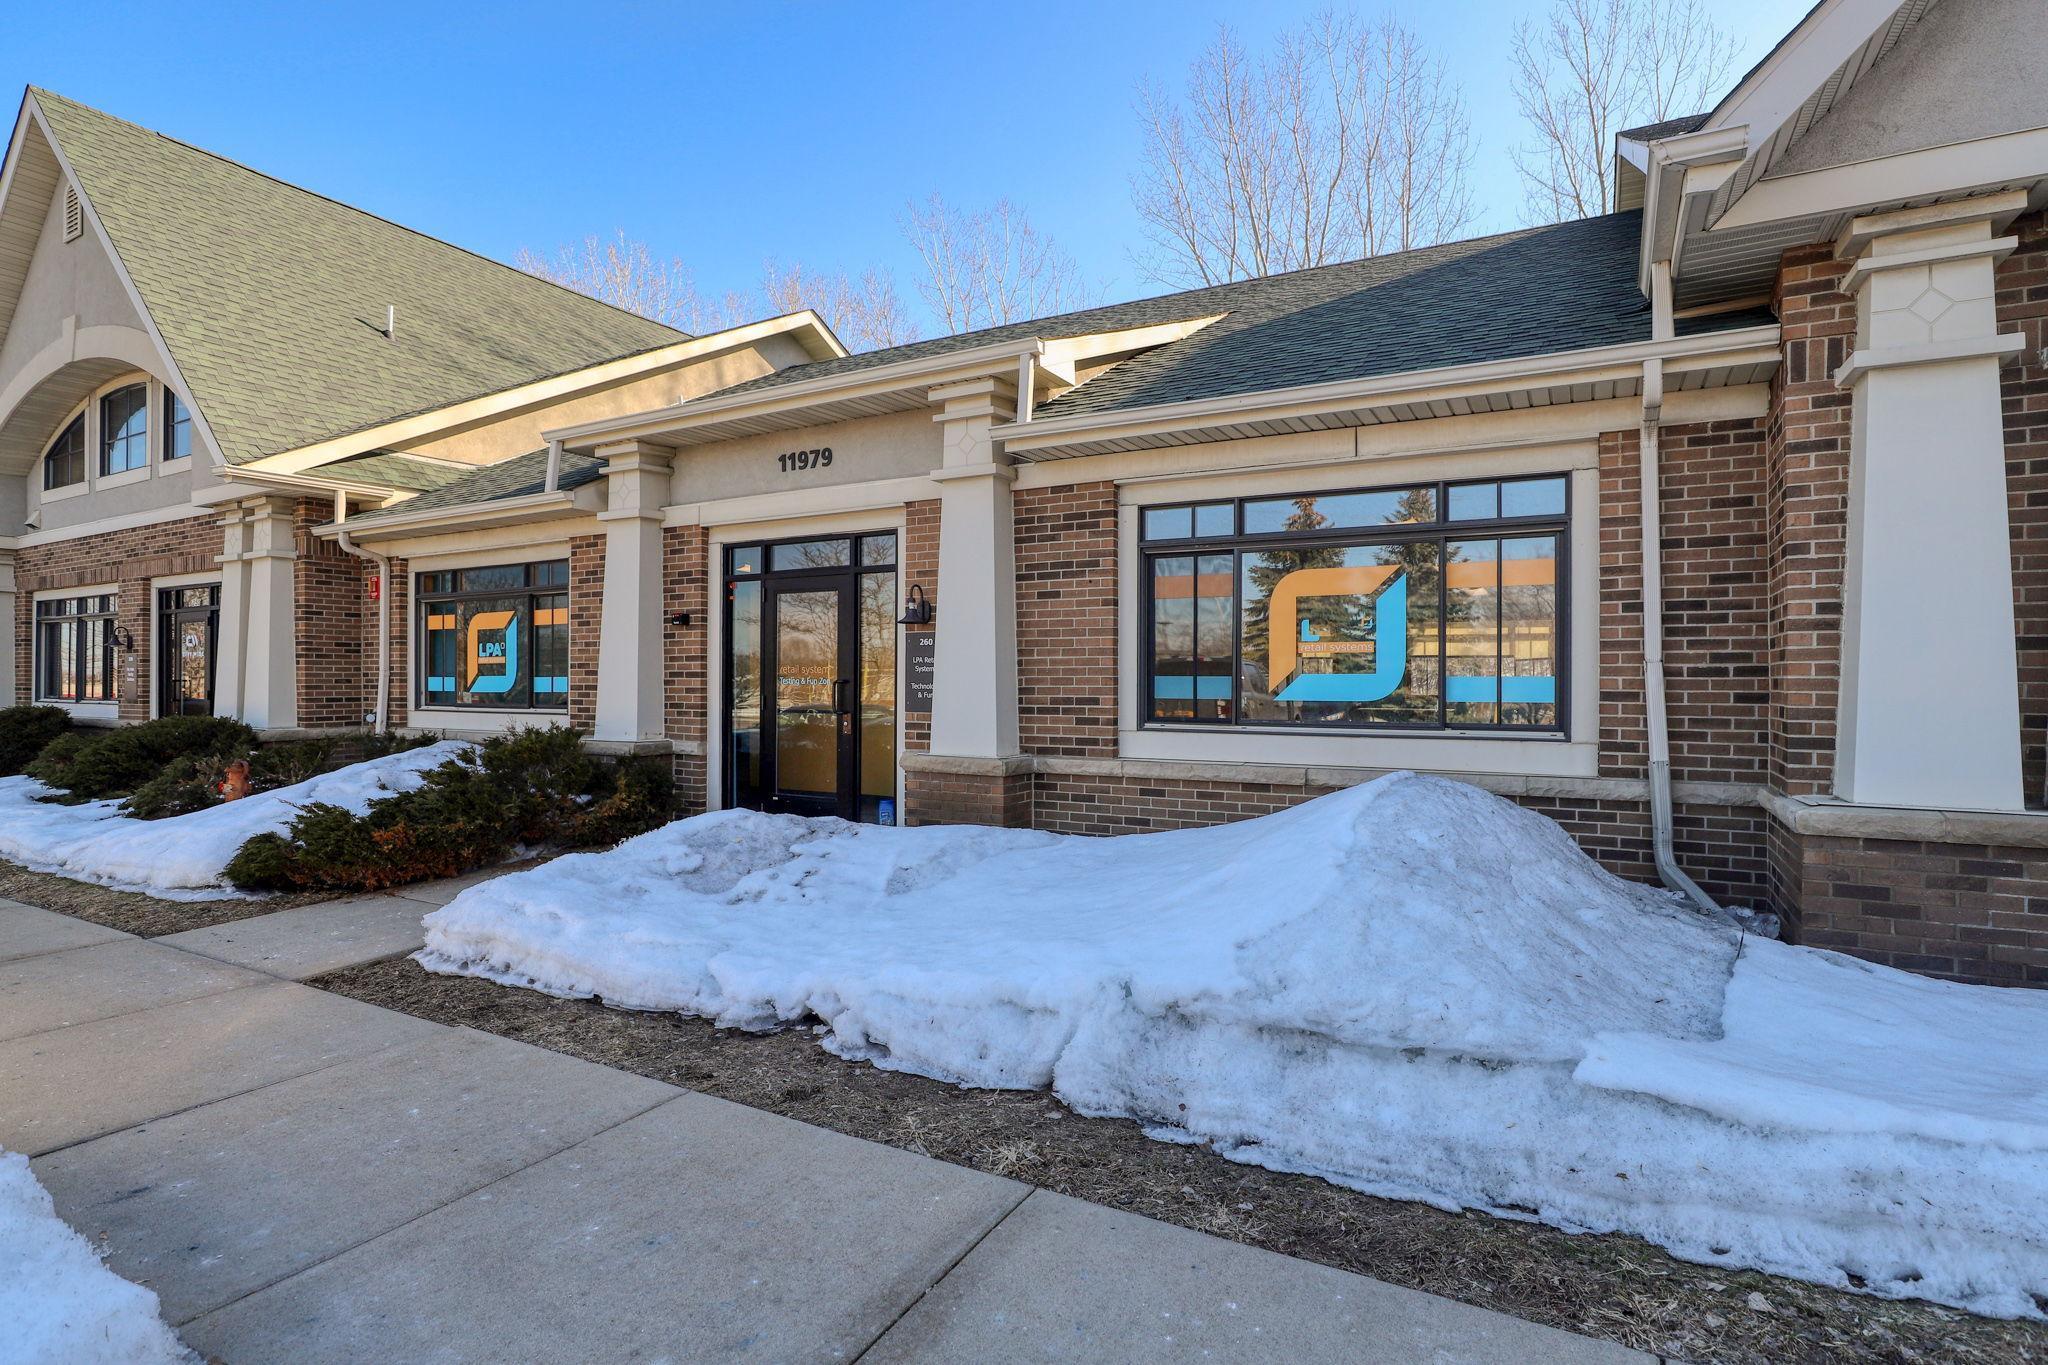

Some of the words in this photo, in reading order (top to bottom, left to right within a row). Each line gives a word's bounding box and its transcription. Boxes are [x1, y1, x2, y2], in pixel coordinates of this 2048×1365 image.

[778, 447, 833, 472] 11979
[919, 638, 933, 646] 260
[1300, 642, 1327, 652] retail
[1329, 642, 1373, 653] systems
[478, 642, 502, 657] LPA
[914, 665, 935, 674] System
